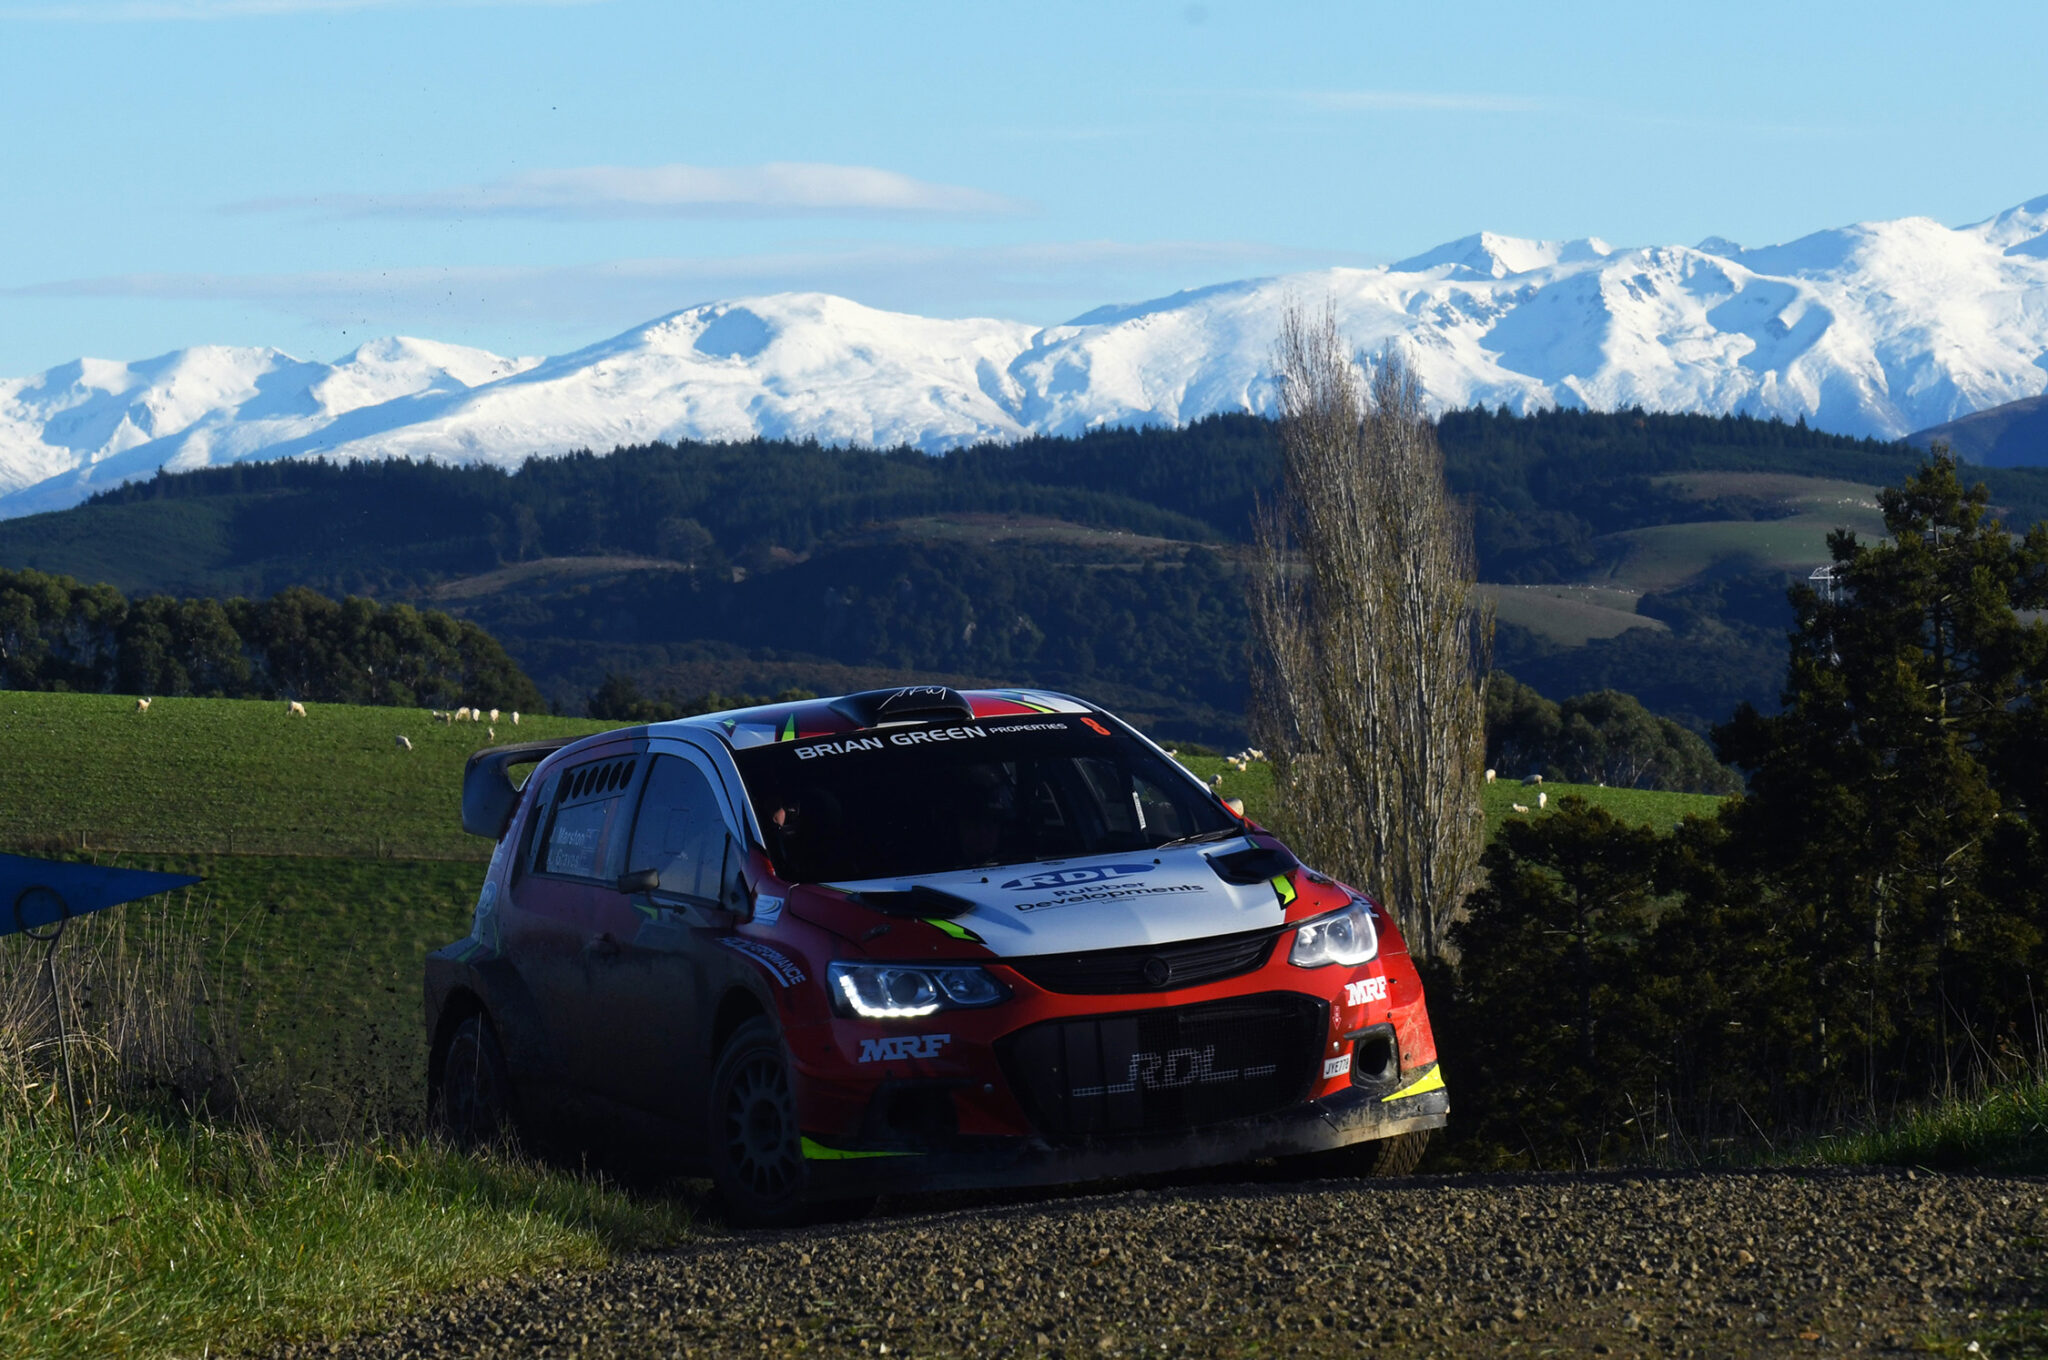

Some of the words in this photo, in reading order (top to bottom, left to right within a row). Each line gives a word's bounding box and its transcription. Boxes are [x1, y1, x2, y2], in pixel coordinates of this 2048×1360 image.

[793, 736, 884, 760] BRIAN
[890, 725, 988, 746] GREEN
[989, 723, 1069, 735] PROPERTIES
[1018, 867, 1128, 888] RDL
[1053, 881, 1146, 897] Rubber
[1014, 884, 1206, 911] Developments
[1344, 975, 1388, 1007] MRF
[858, 1033, 952, 1064] MRF
